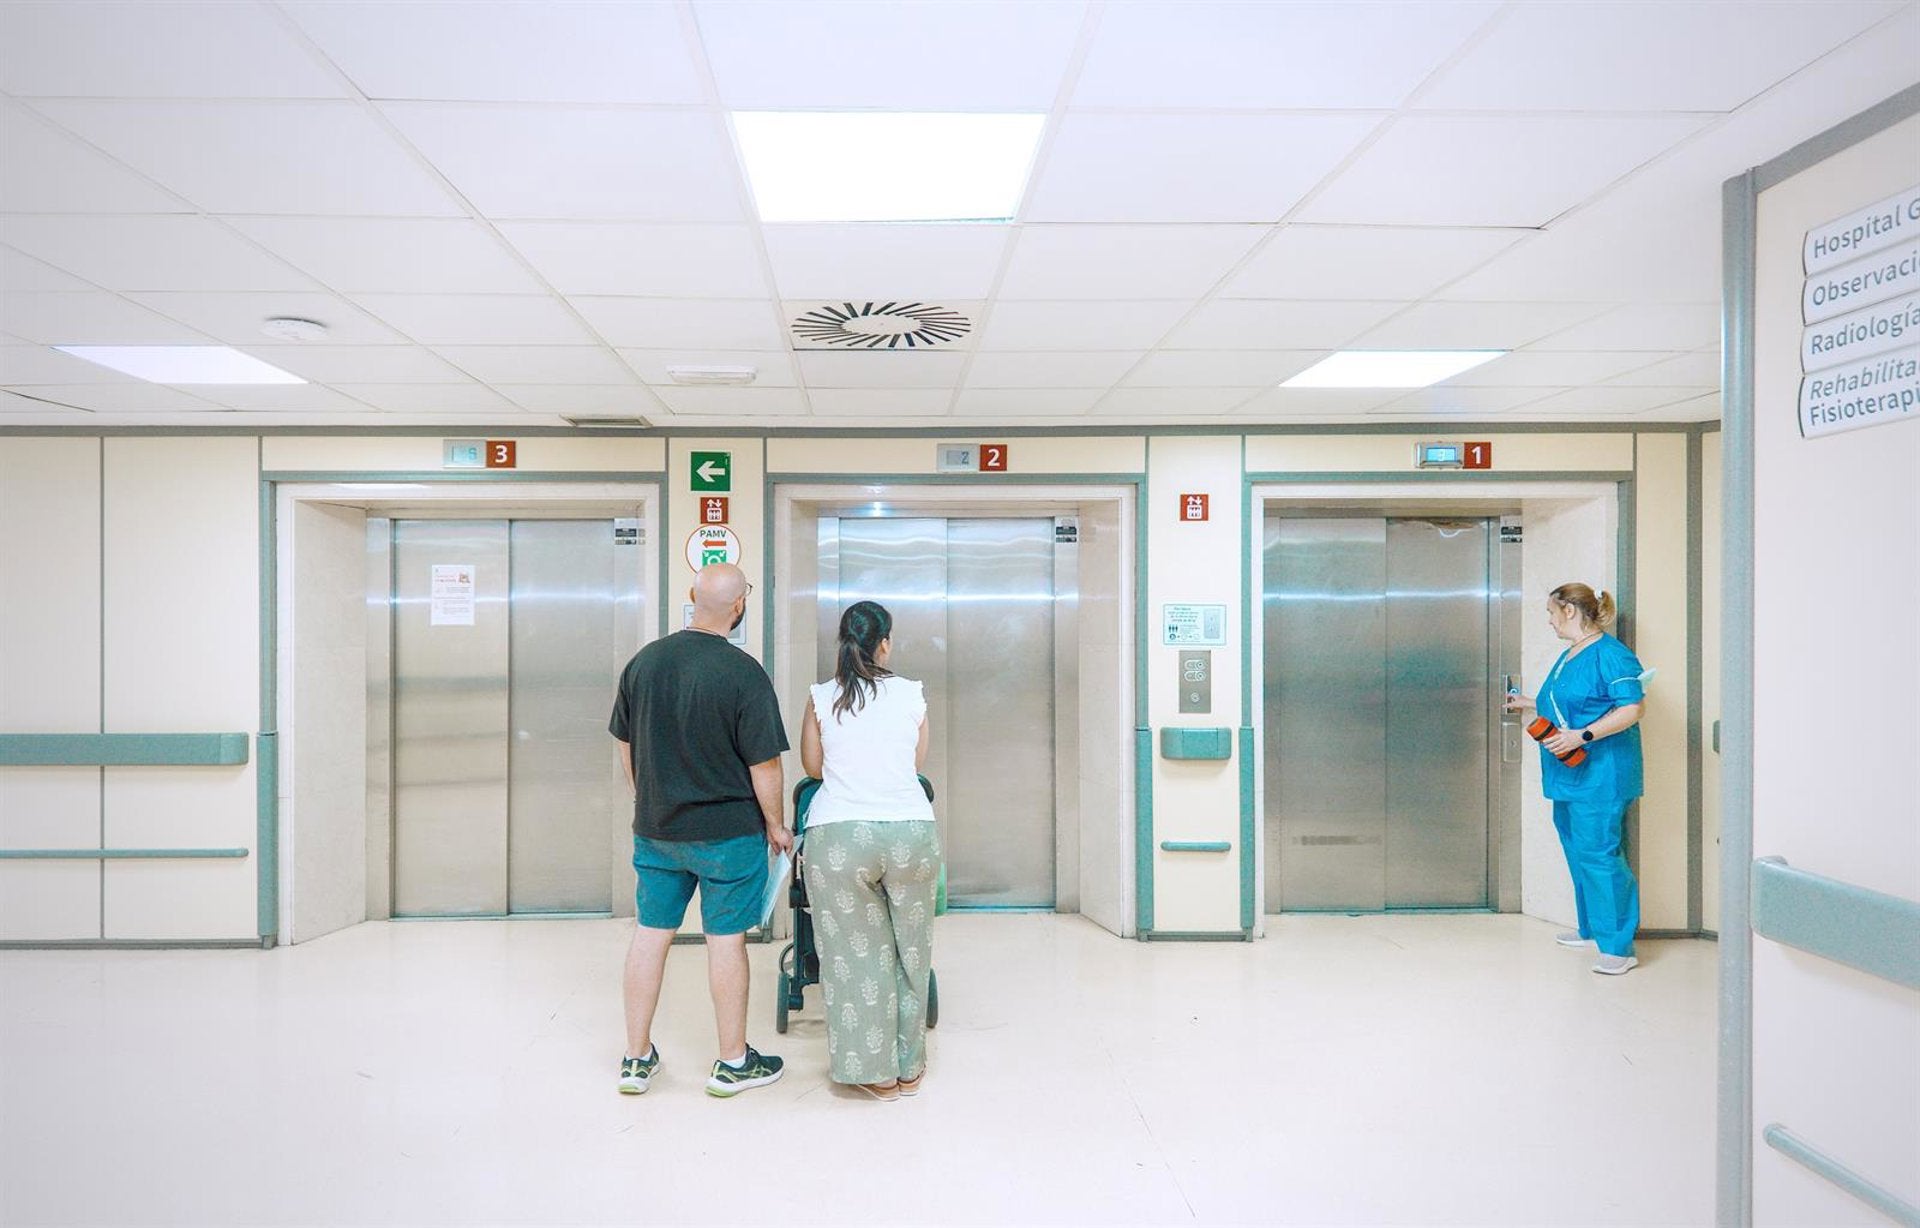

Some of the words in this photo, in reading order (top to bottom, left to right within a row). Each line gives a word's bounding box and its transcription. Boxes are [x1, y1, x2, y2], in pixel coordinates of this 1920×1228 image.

[1814, 205, 1901, 258] Hospital
[1813, 250, 1920, 305] Observaci
[1811, 303, 1920, 354] Radiología
[1810, 359, 1920, 400] Rehabilita
[495, 445, 507, 463] 3
[987, 448, 1000, 466] 2
[1471, 446, 1481, 464] 1
[700, 530, 727, 538] PAMV
